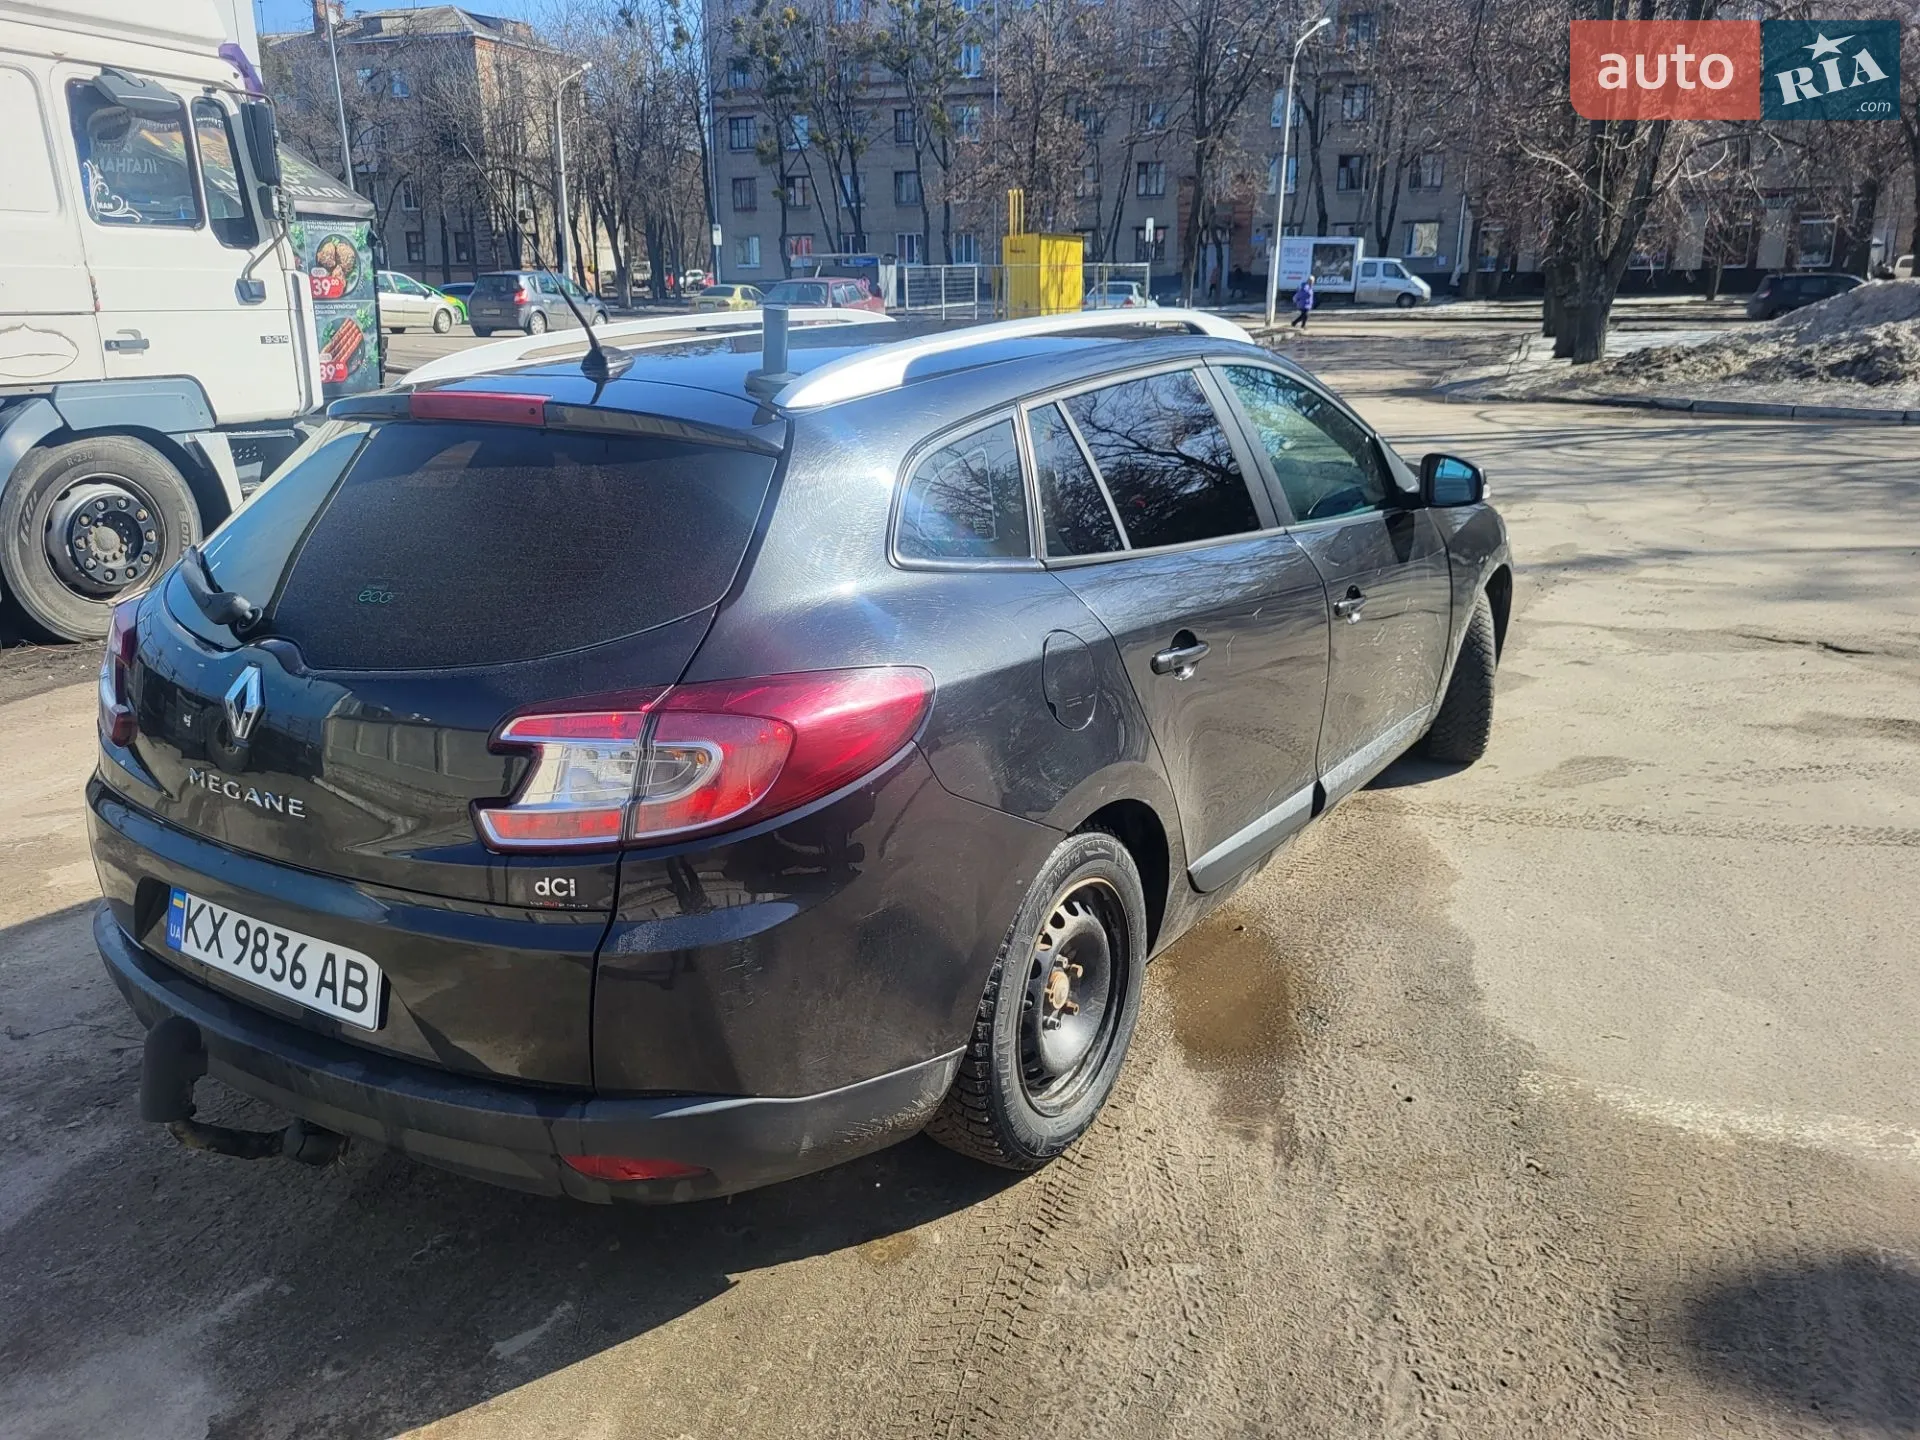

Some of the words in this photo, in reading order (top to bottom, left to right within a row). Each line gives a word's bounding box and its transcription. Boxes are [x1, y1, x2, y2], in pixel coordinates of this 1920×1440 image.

[312, 279, 331, 296] 39
[189, 767, 306, 818] MEGANE
[170, 923, 181, 941] UA
[184, 897, 228, 959] KX
[233, 919, 308, 990] 9836
[314, 952, 368, 1013] AB
